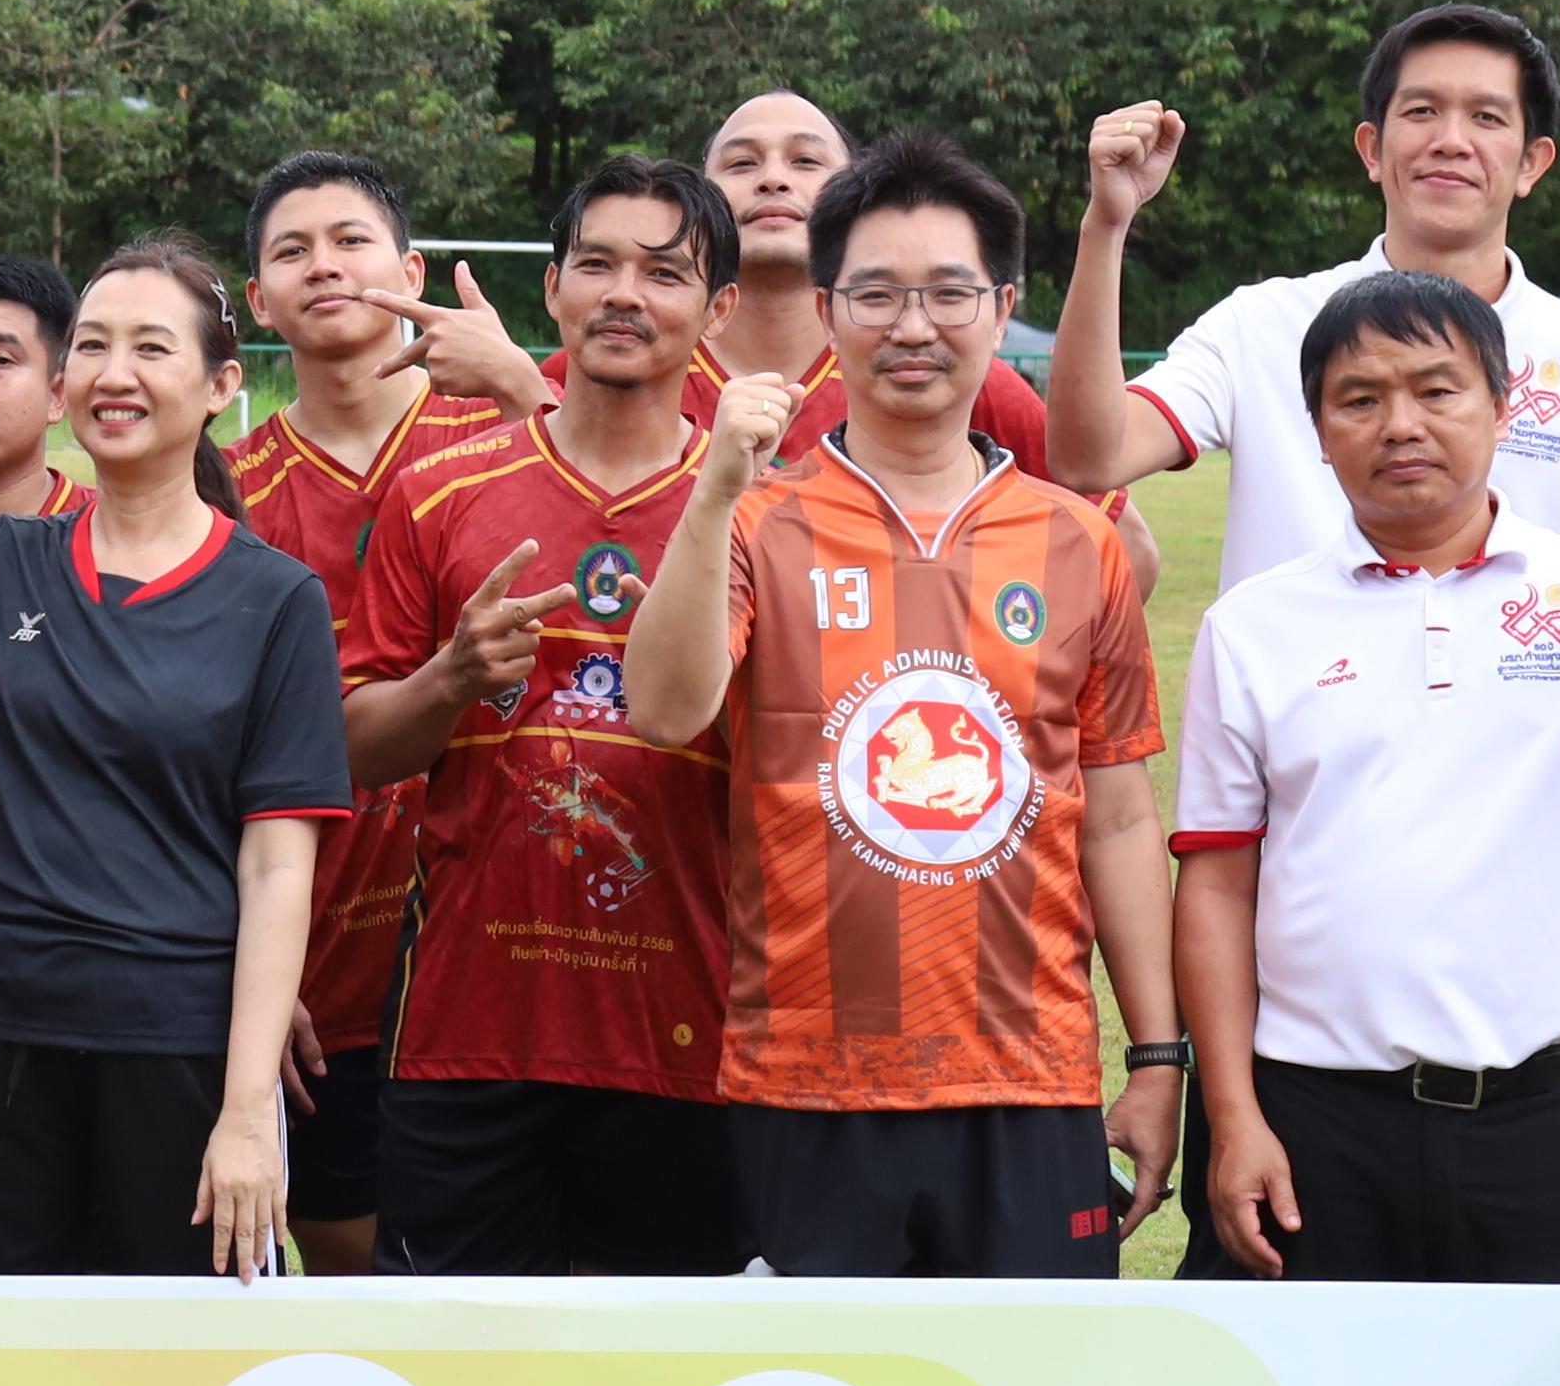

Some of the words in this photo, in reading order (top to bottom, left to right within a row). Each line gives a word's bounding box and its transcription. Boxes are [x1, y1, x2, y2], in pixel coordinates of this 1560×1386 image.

[809, 567, 871, 630] 13
[822, 671, 879, 742] PUBLIC
[851, 840, 955, 886] KAMPHAENG
[964, 857, 1001, 883] PHET
[1002, 772, 1046, 861] UNIVERSIT
[641, 935, 674, 951] 2568
